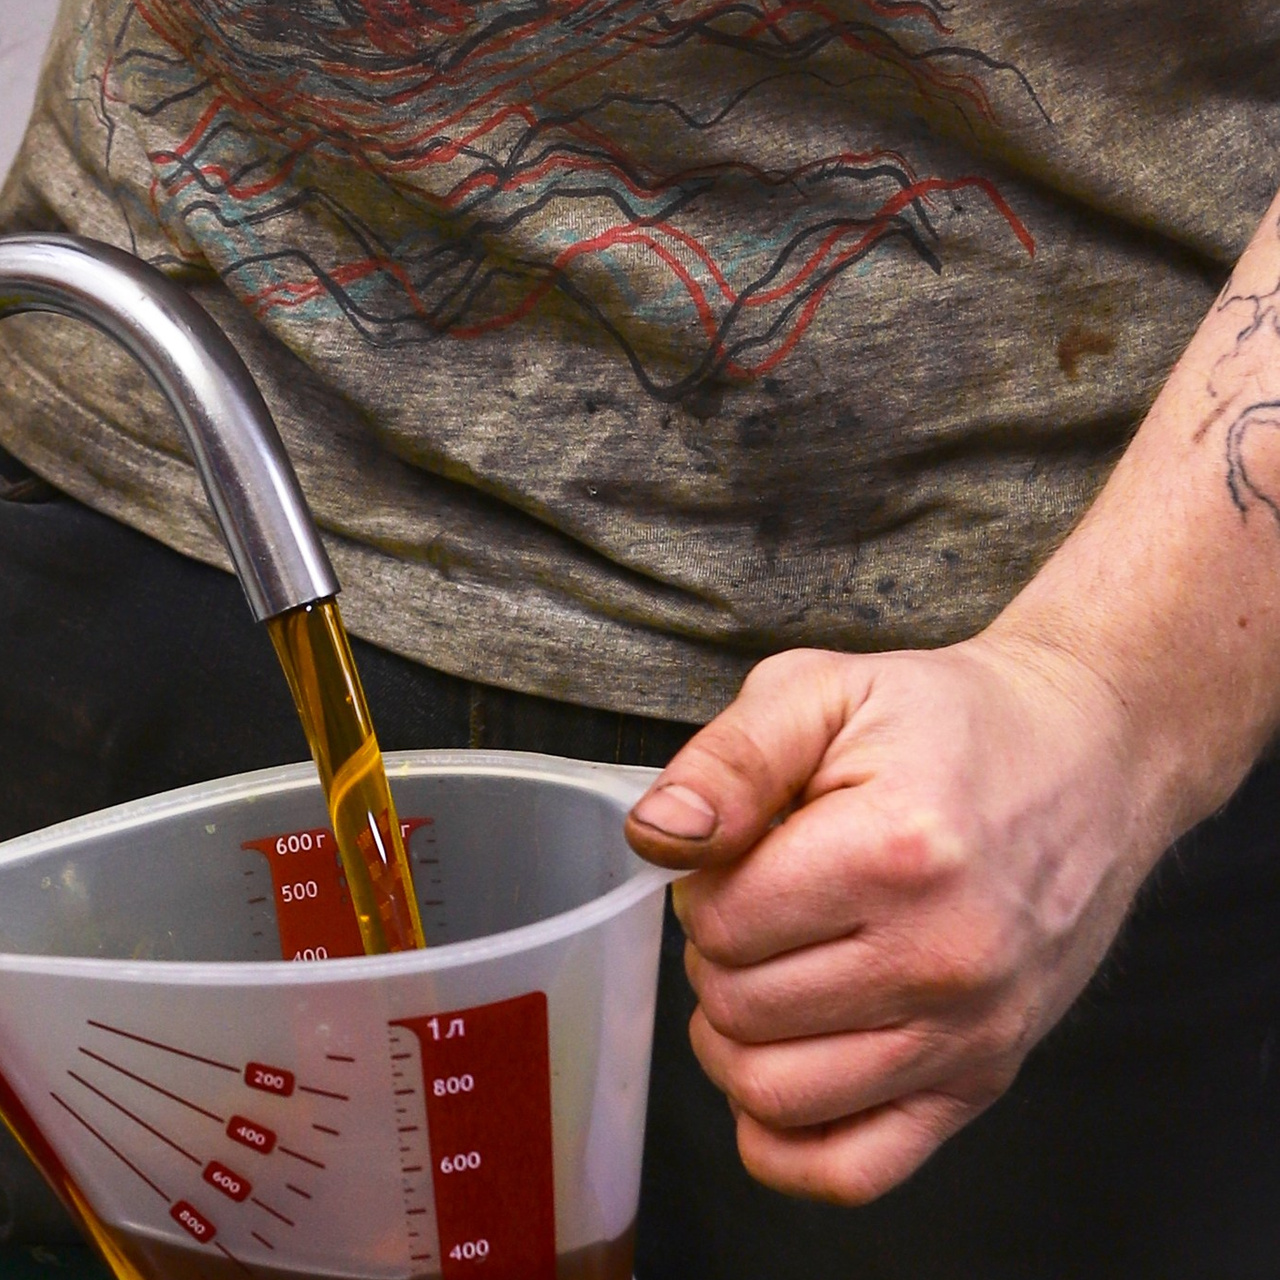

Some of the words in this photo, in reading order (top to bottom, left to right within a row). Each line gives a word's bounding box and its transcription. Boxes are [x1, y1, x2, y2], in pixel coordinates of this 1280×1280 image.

[275, 833, 313, 855] 600
[280, 880, 318, 903] 500
[252, 1069, 285, 1090] 200
[432, 1073, 475, 1097] 800
[235, 1124, 266, 1147] 400
[439, 1150, 482, 1175] 600
[211, 1170, 242, 1195] 600
[177, 1208, 206, 1236] 800
[448, 1238, 490, 1261] 400
